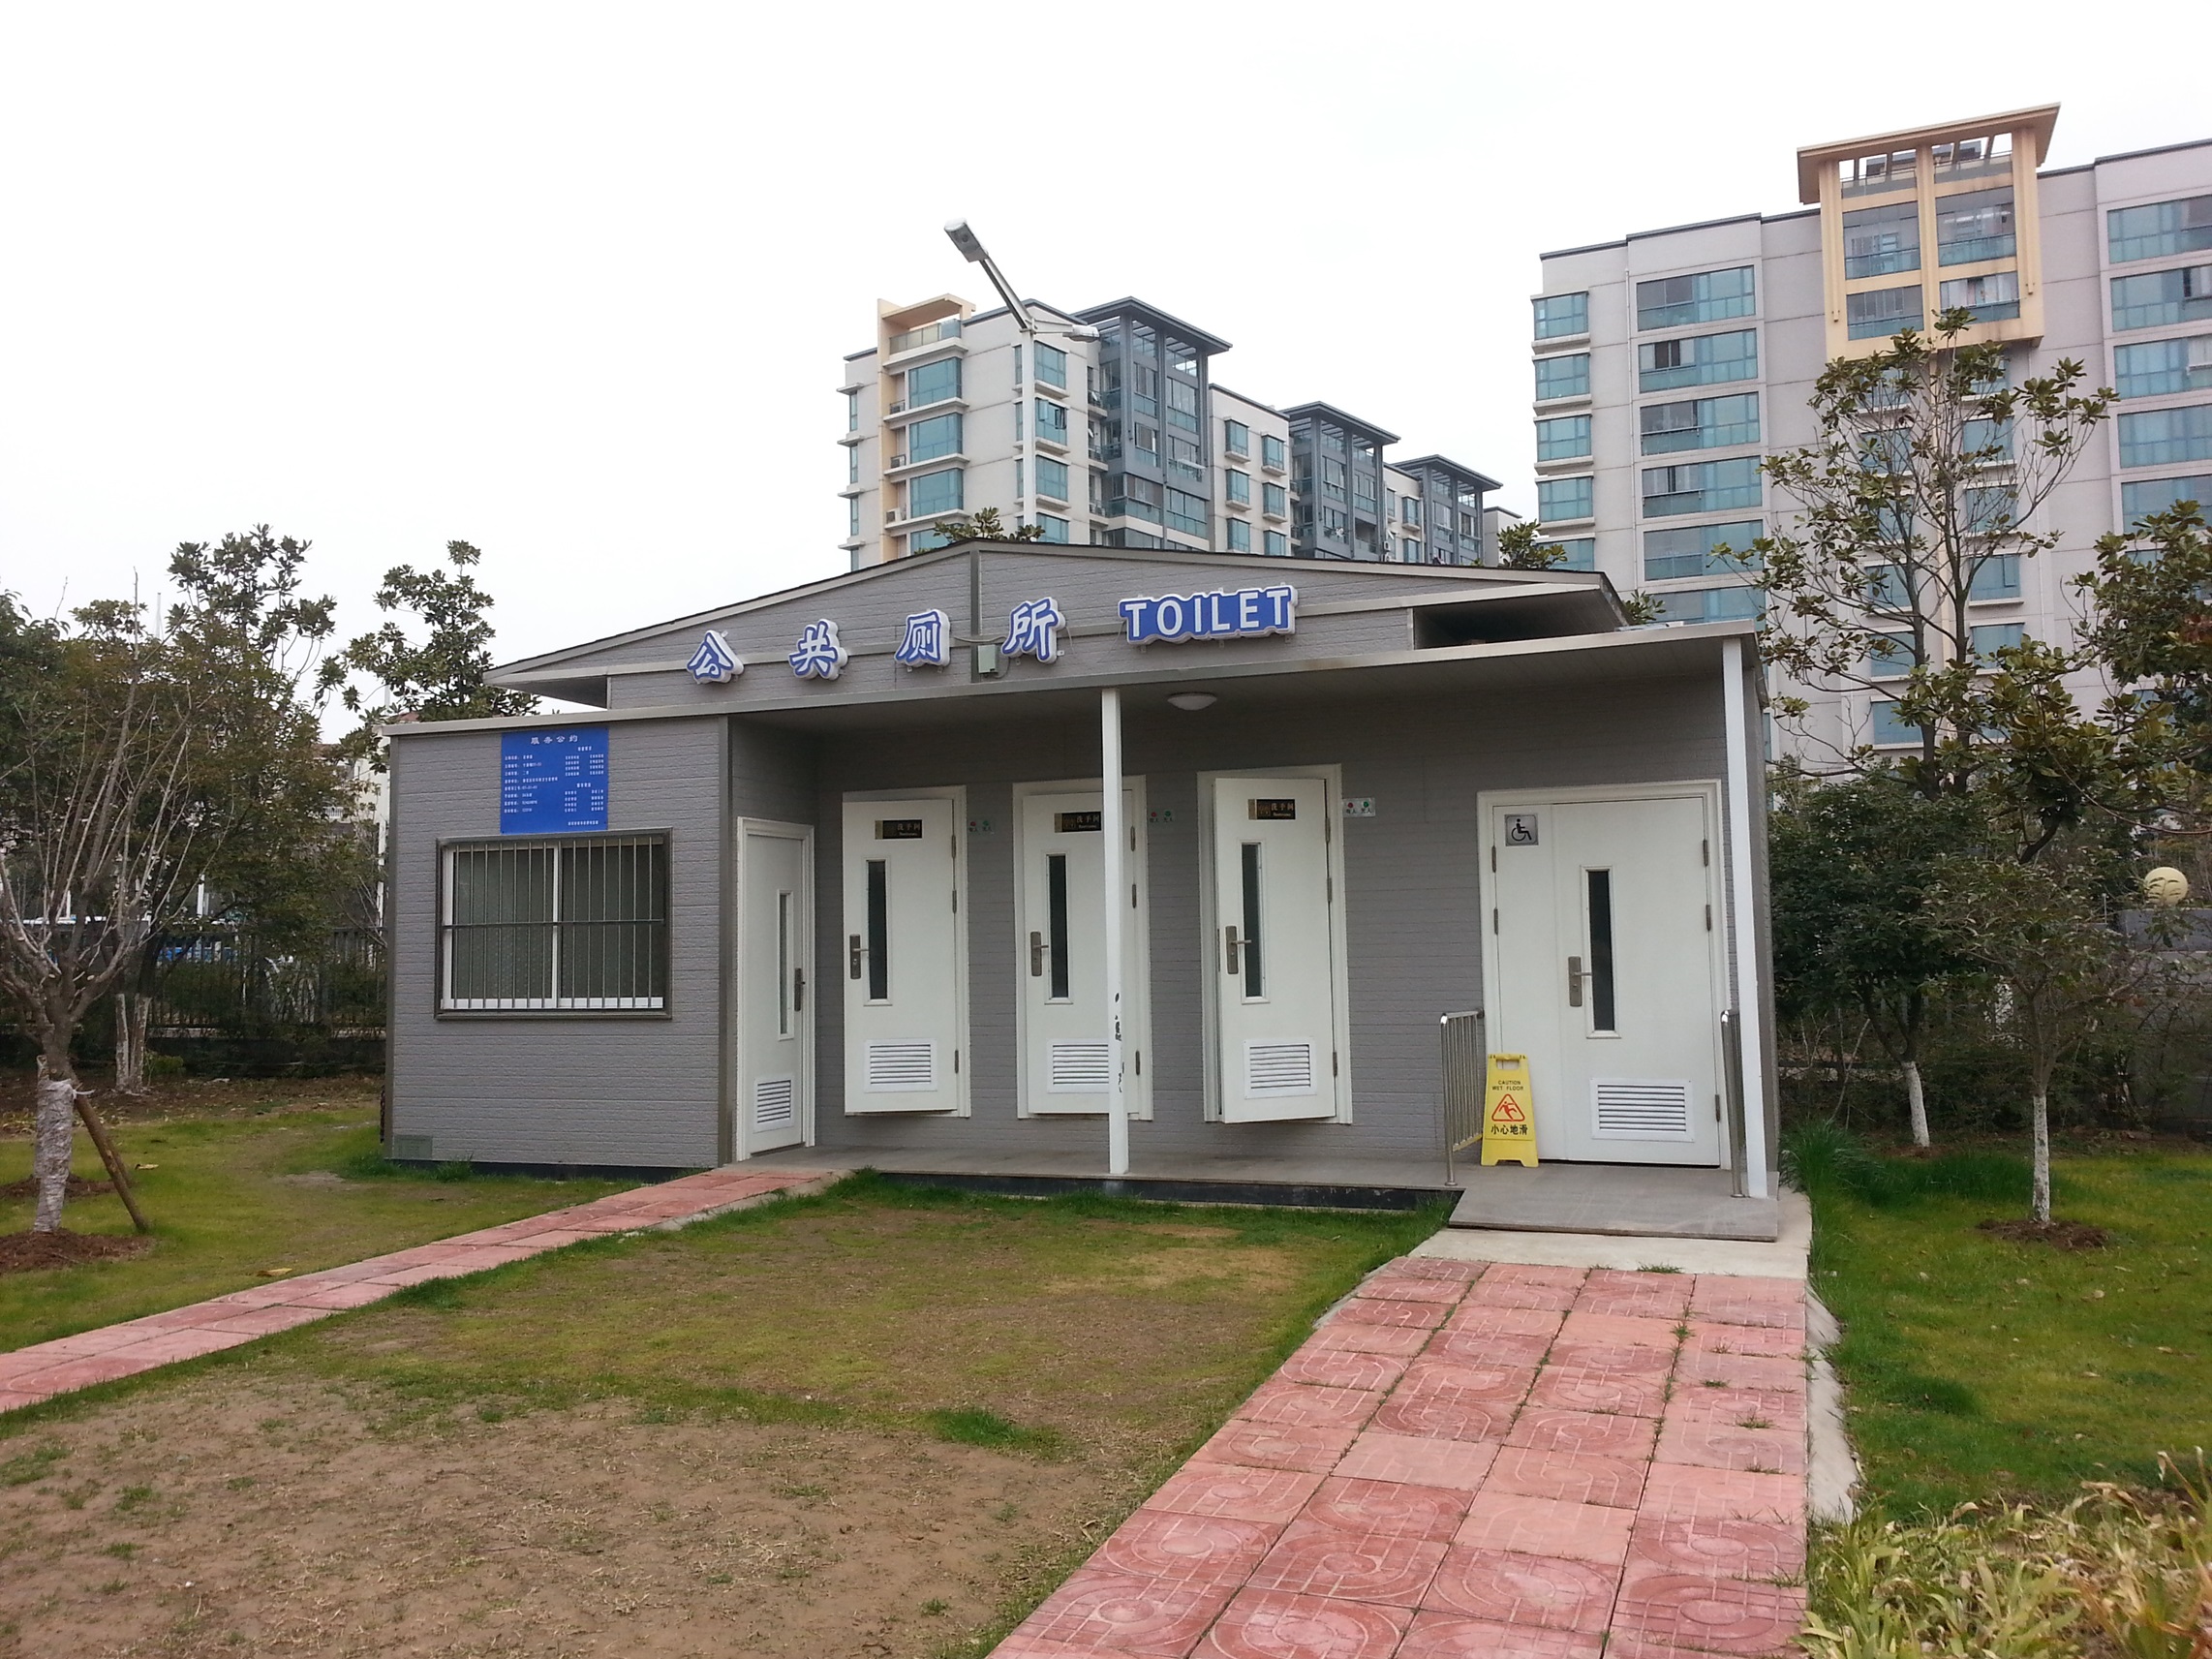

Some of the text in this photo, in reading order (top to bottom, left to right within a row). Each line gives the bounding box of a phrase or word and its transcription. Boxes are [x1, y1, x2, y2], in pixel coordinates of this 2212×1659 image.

[1125, 588, 1292, 639] TOILET
[687, 599, 1059, 683] 公共厕所
[531, 734, 578, 745] 服务公约
[1490, 1124, 1528, 1135] 小心地滑
